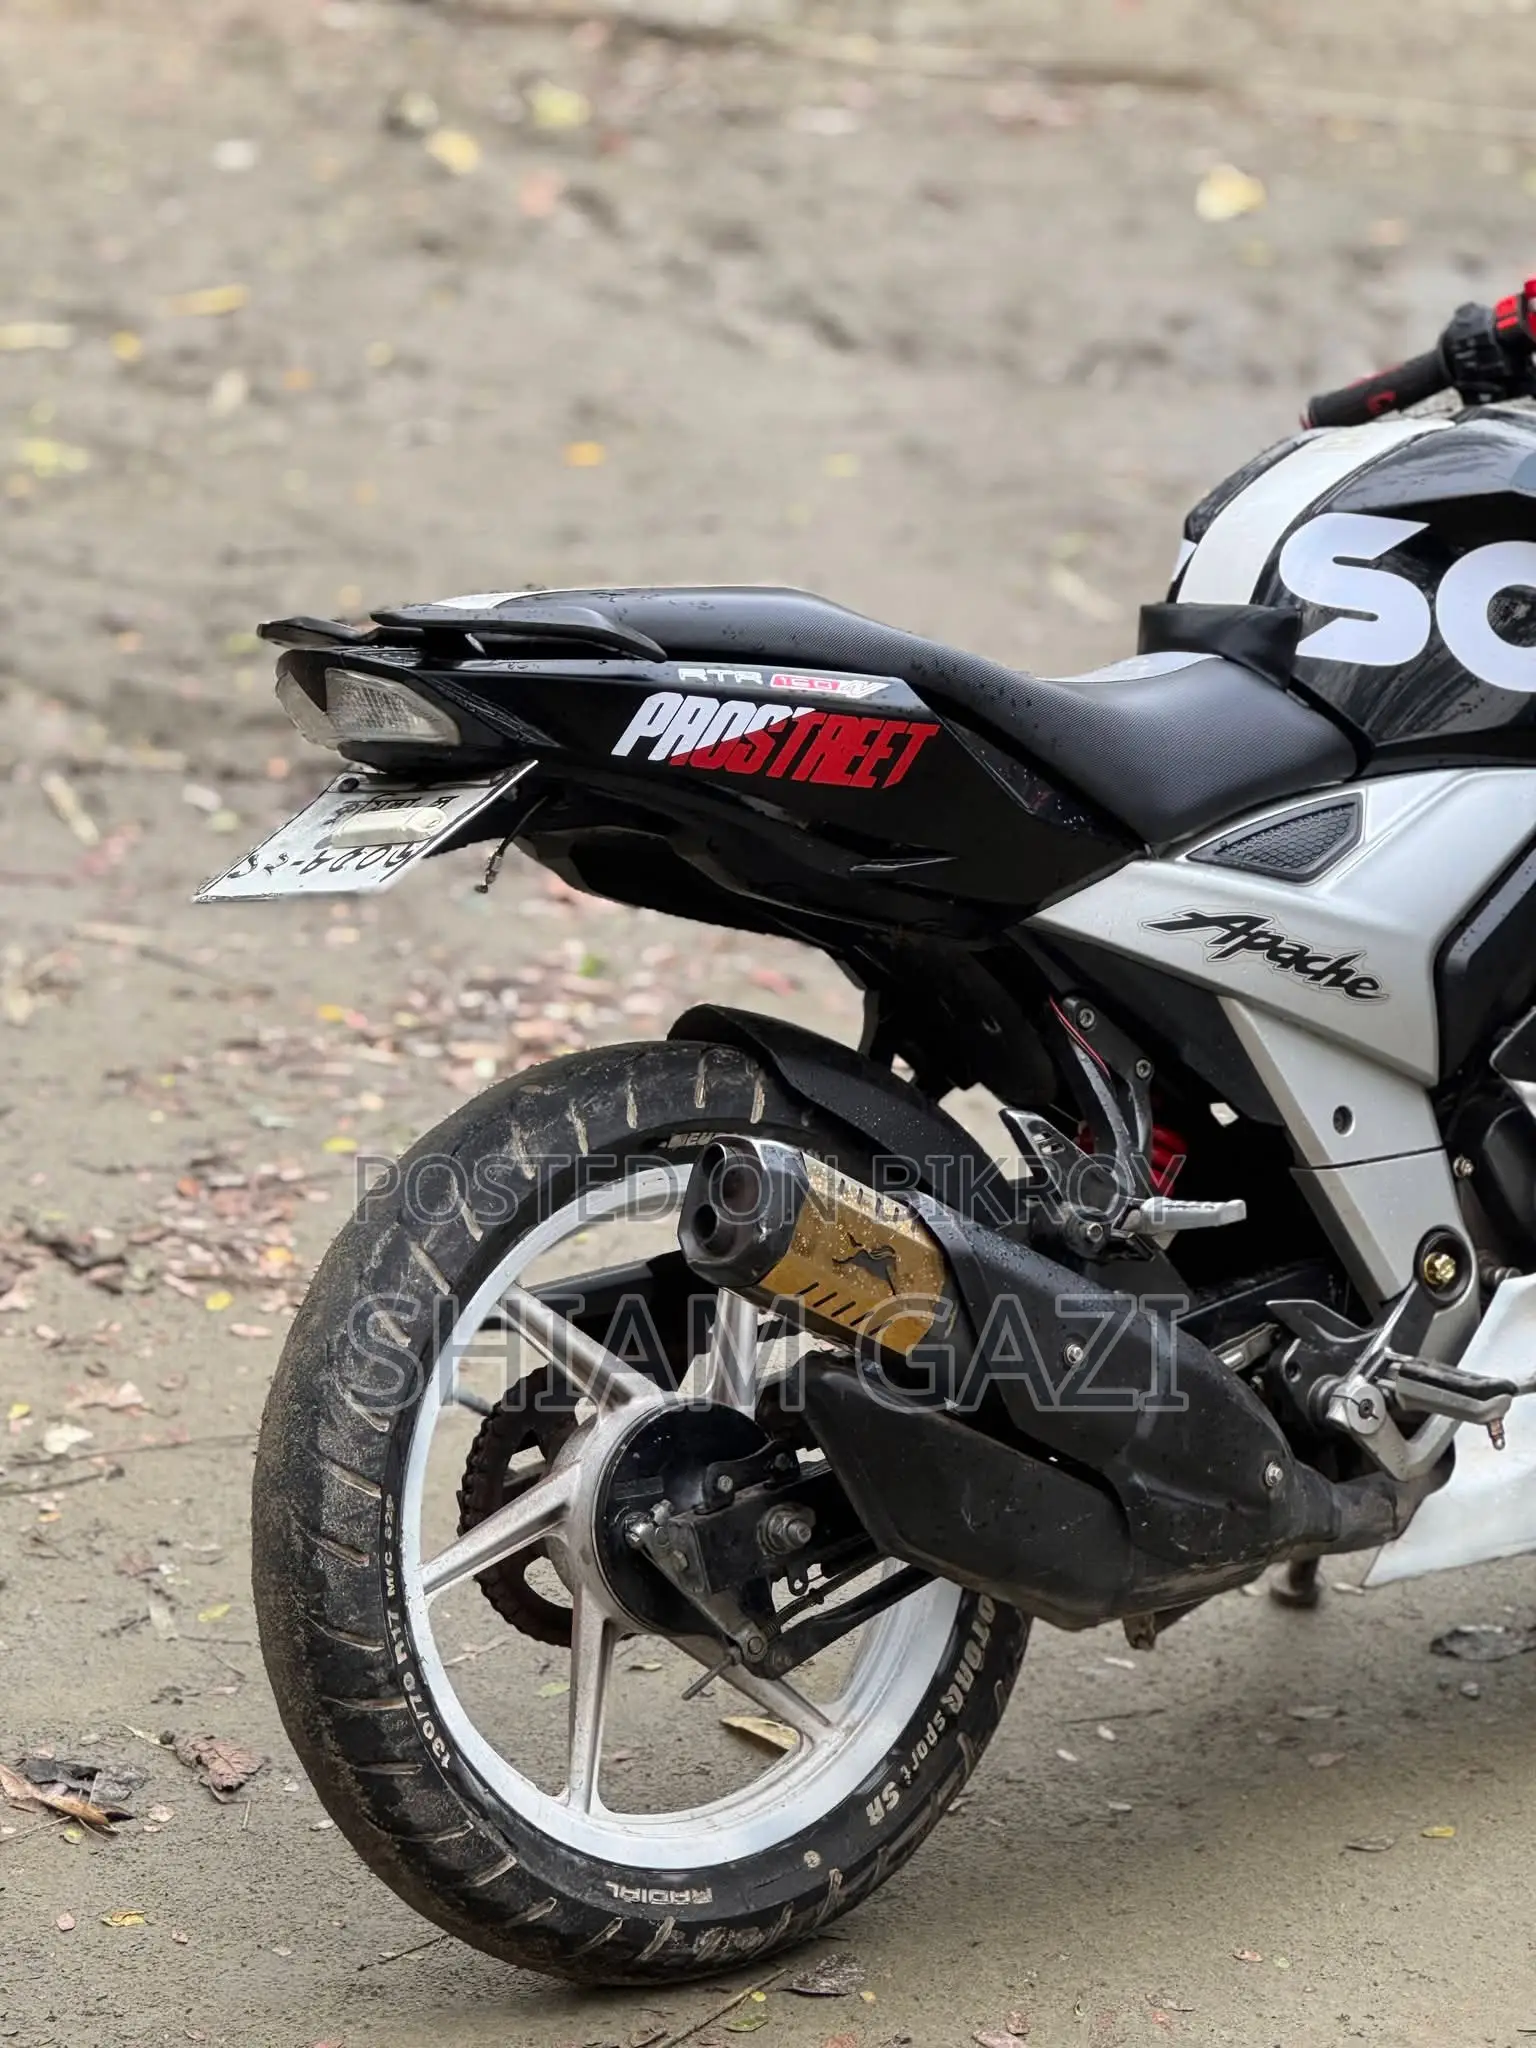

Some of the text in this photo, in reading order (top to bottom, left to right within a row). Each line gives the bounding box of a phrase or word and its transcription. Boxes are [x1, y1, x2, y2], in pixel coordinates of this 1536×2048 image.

[677, 667, 764, 685] RTR
[611, 691, 941, 789] PROSTREET
[1142, 909, 1389, 1001] Apache
[941, 1593, 996, 1715] OTORQ
[605, 1880, 714, 1905] RADIAL
